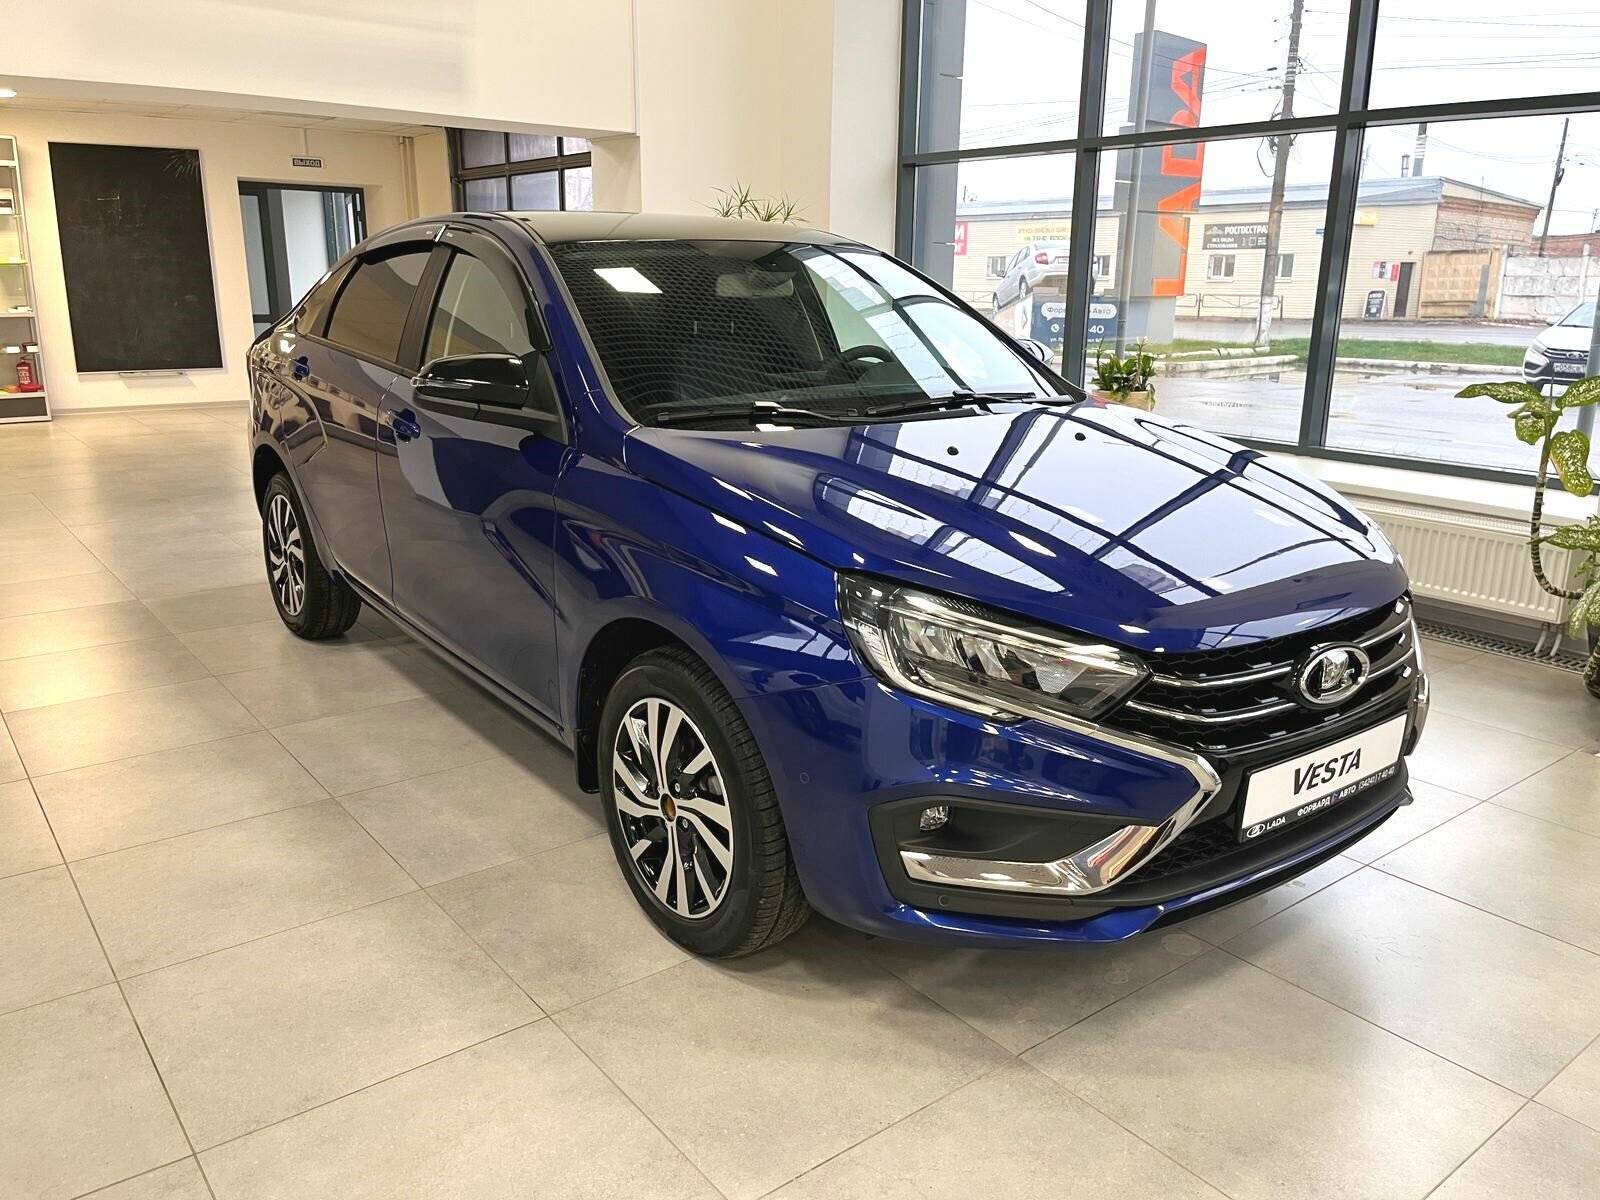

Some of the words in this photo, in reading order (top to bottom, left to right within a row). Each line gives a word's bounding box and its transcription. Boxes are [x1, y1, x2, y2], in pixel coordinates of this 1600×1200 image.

[1152, 47, 1207, 296] LADA
[1294, 748, 1361, 795] VESTA
[1266, 816, 1286, 830] LADA
[1297, 797, 1331, 816] ФОРВАРД
[1338, 784, 1357, 799] АВТО
